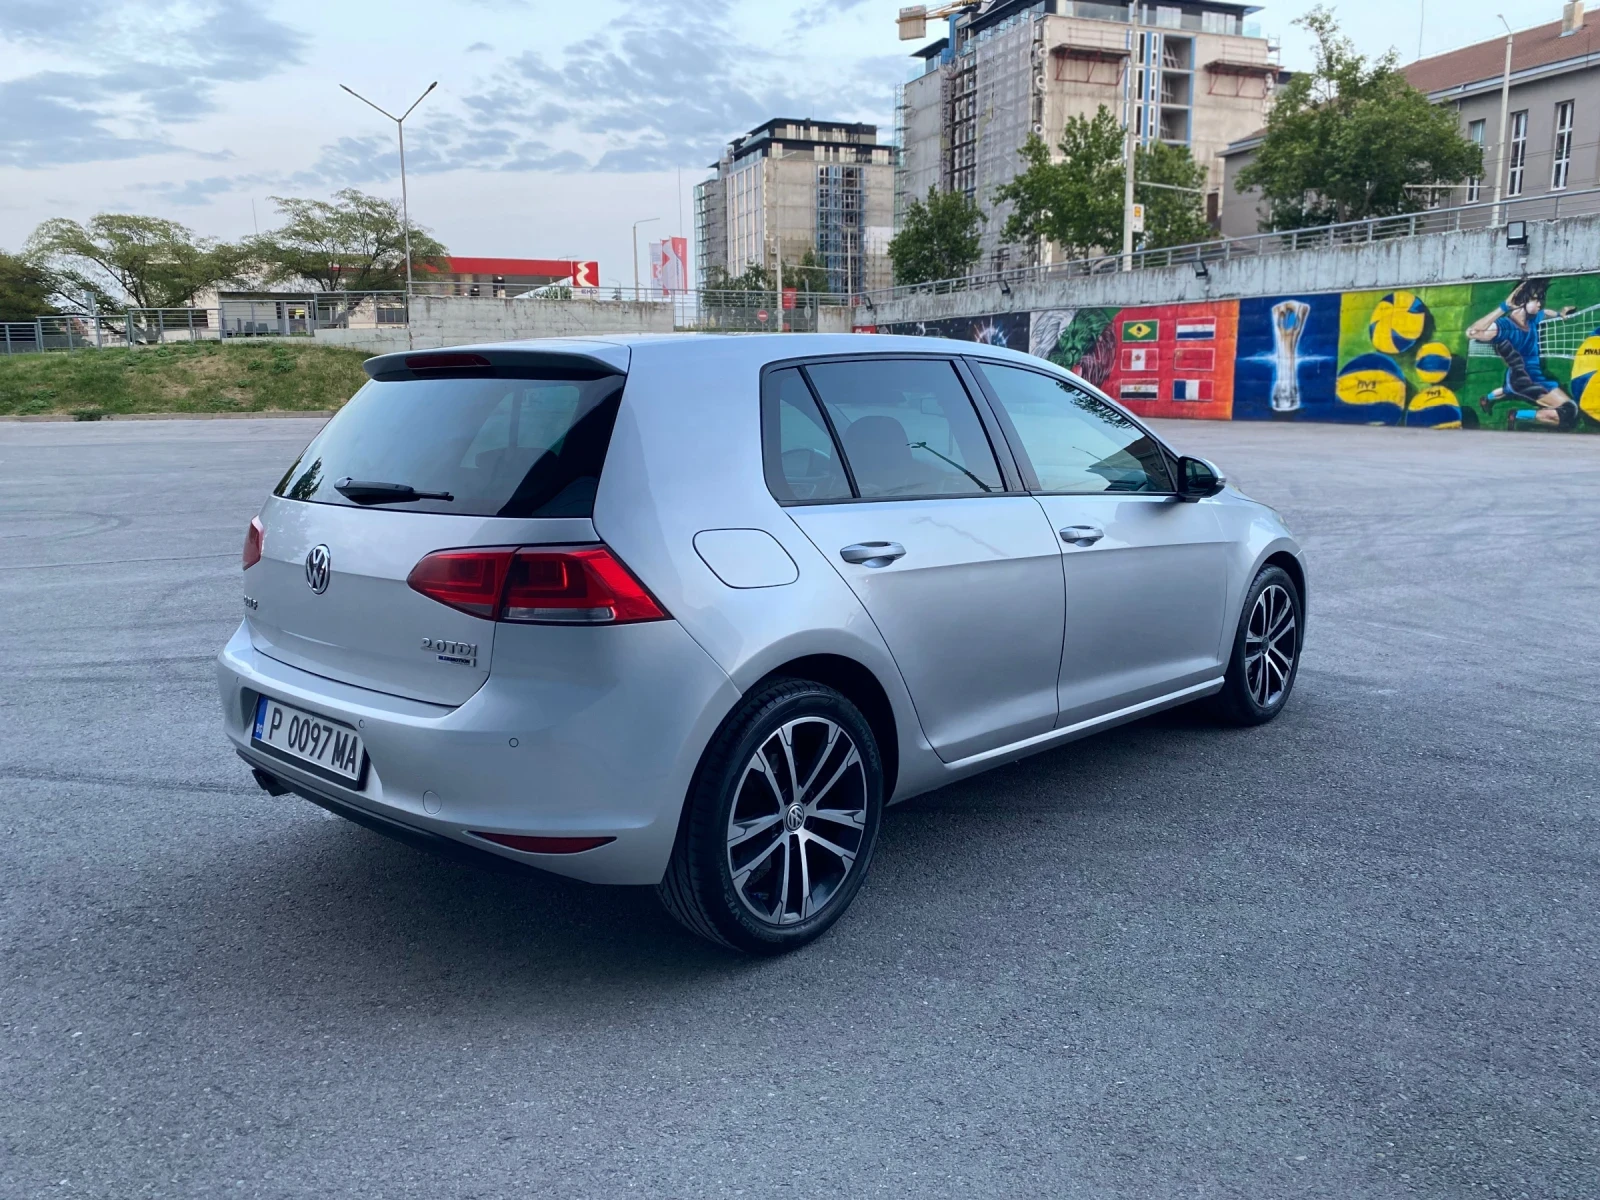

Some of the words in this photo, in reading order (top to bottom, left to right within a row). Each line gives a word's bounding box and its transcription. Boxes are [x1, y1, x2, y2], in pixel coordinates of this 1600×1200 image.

[269, 707, 283, 740] P
[288, 715, 333, 760] 0097
[331, 730, 358, 774] MA
